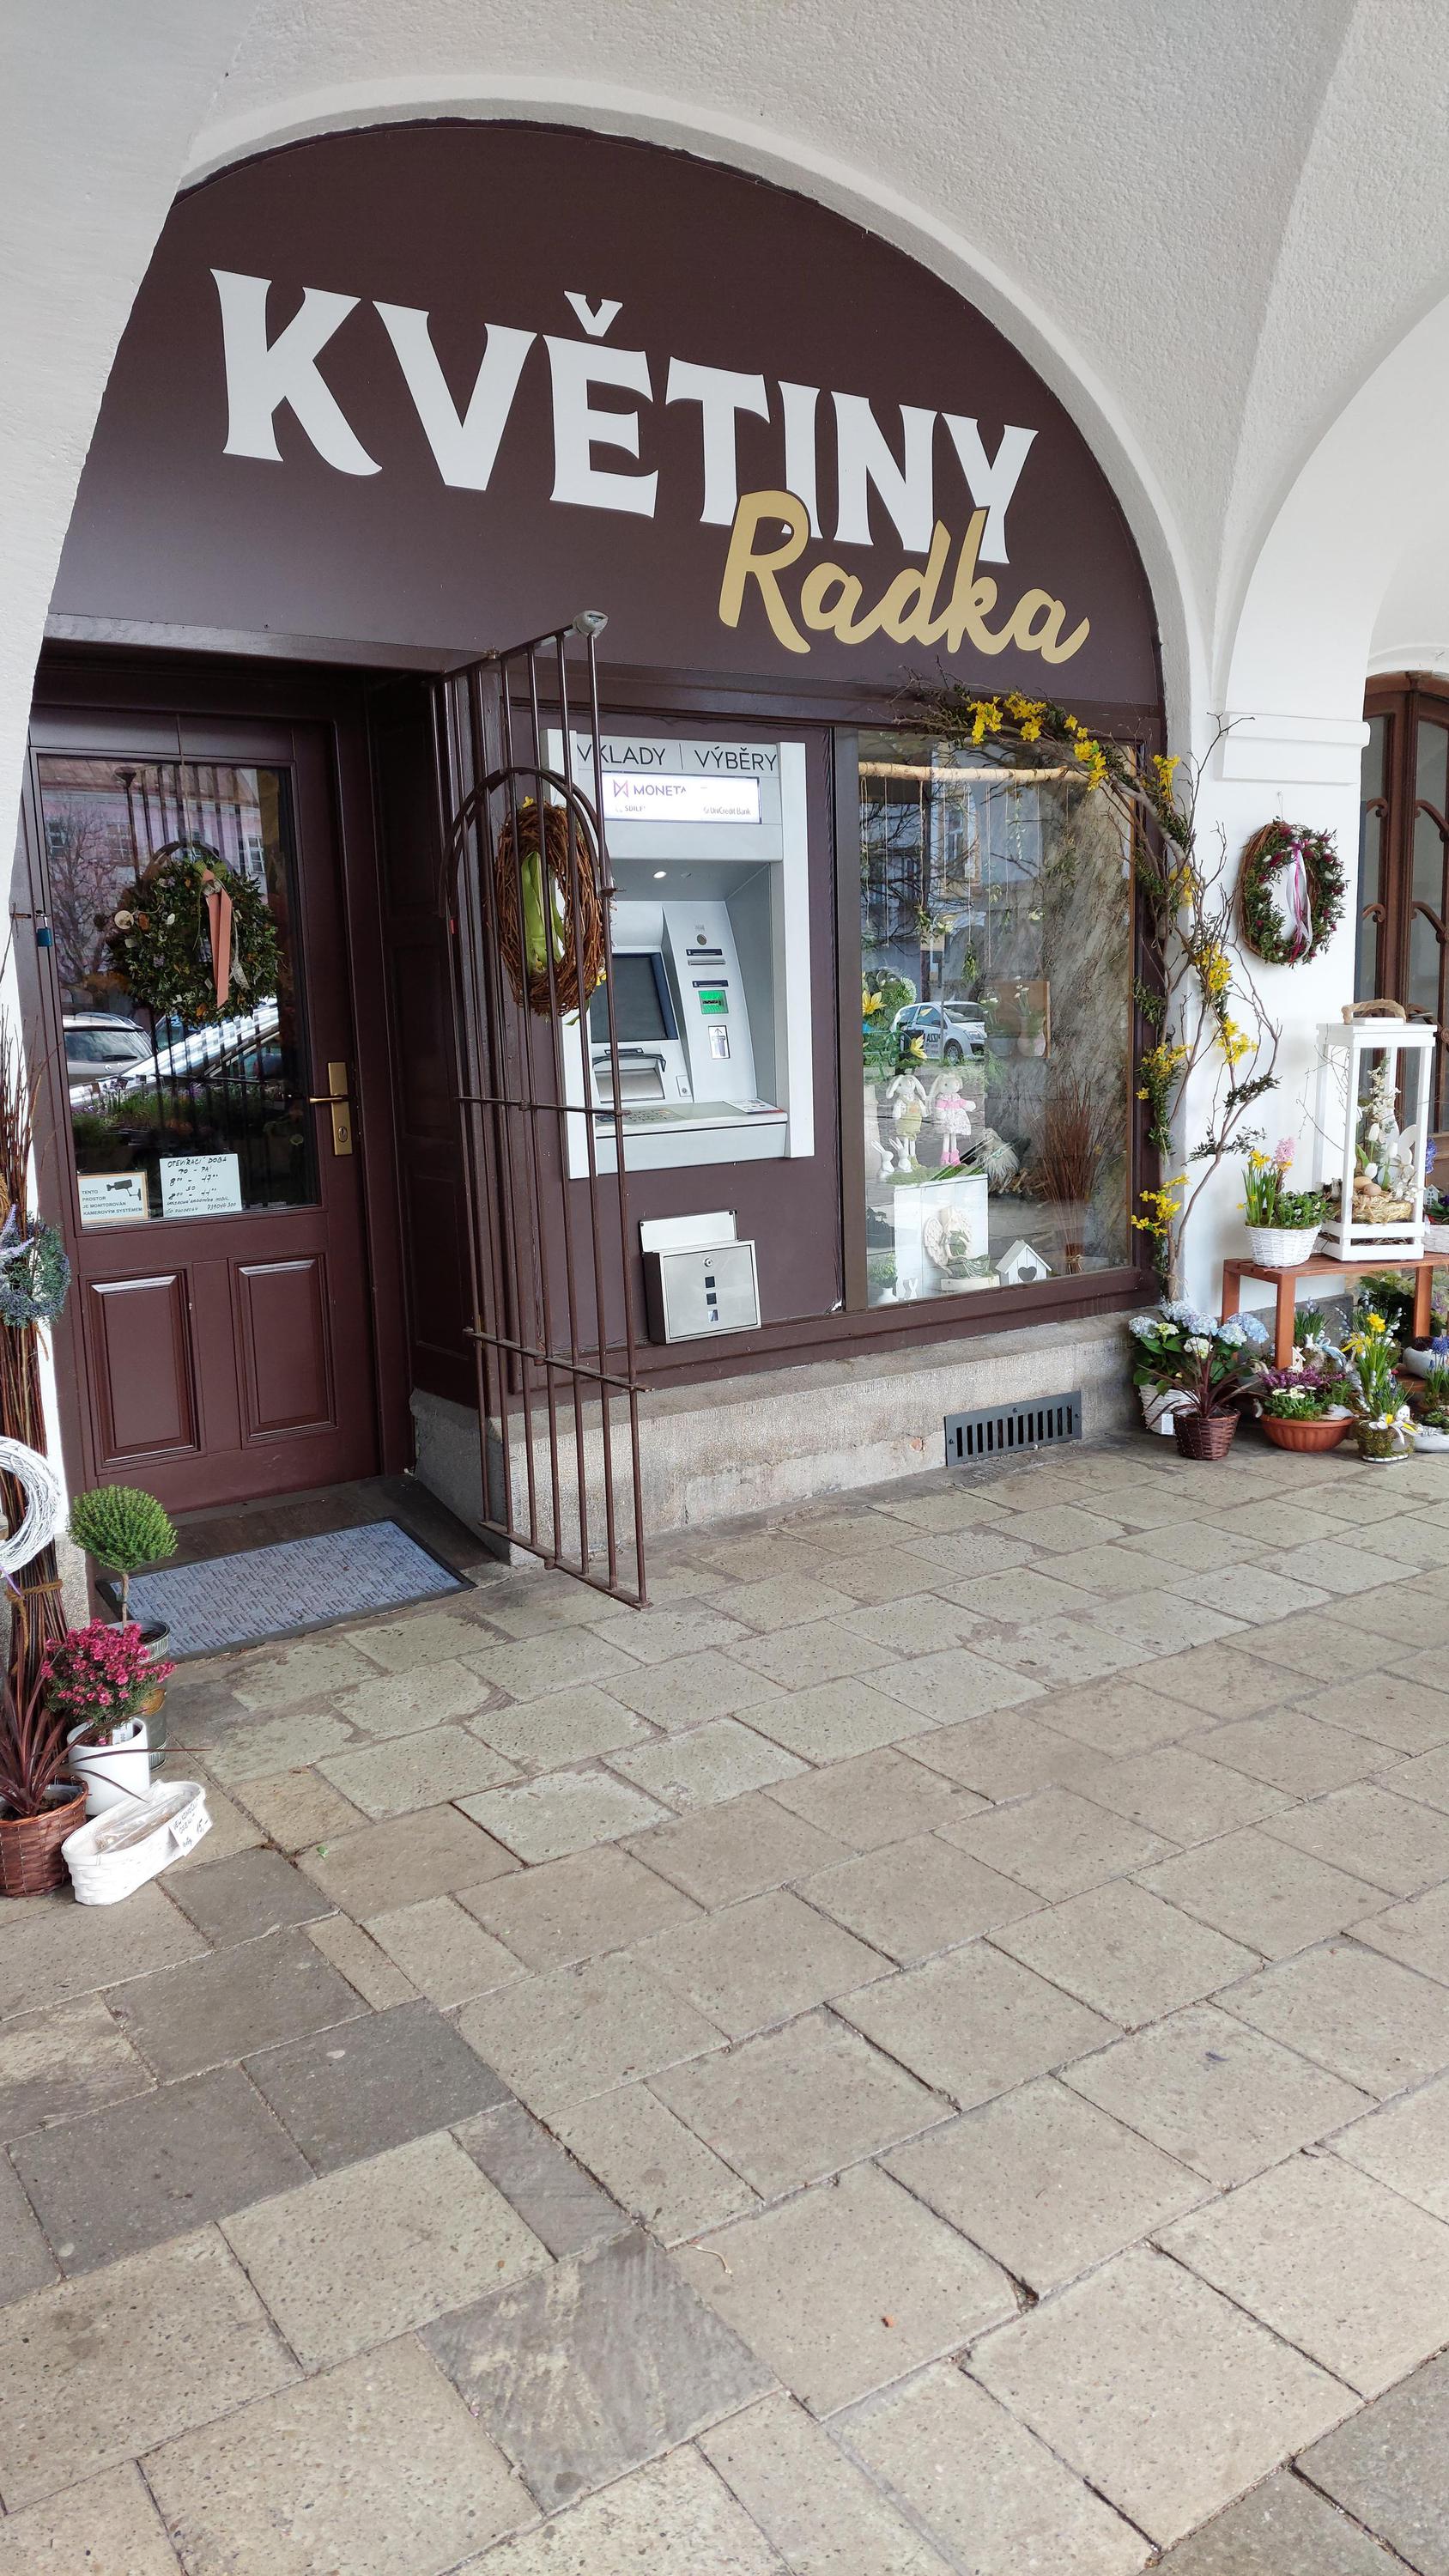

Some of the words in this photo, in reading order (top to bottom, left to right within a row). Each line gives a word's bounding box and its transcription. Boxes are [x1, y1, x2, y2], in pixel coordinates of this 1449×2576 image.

[210, 269, 1039, 564] KVĚTINY
[718, 489, 1090, 665] Radka
[577, 743, 666, 766] VKLADY
[694, 745, 777, 772] VÝBĚRY
[710, 806, 736, 815] UniCredit
[737, 807, 752, 817] Bank
